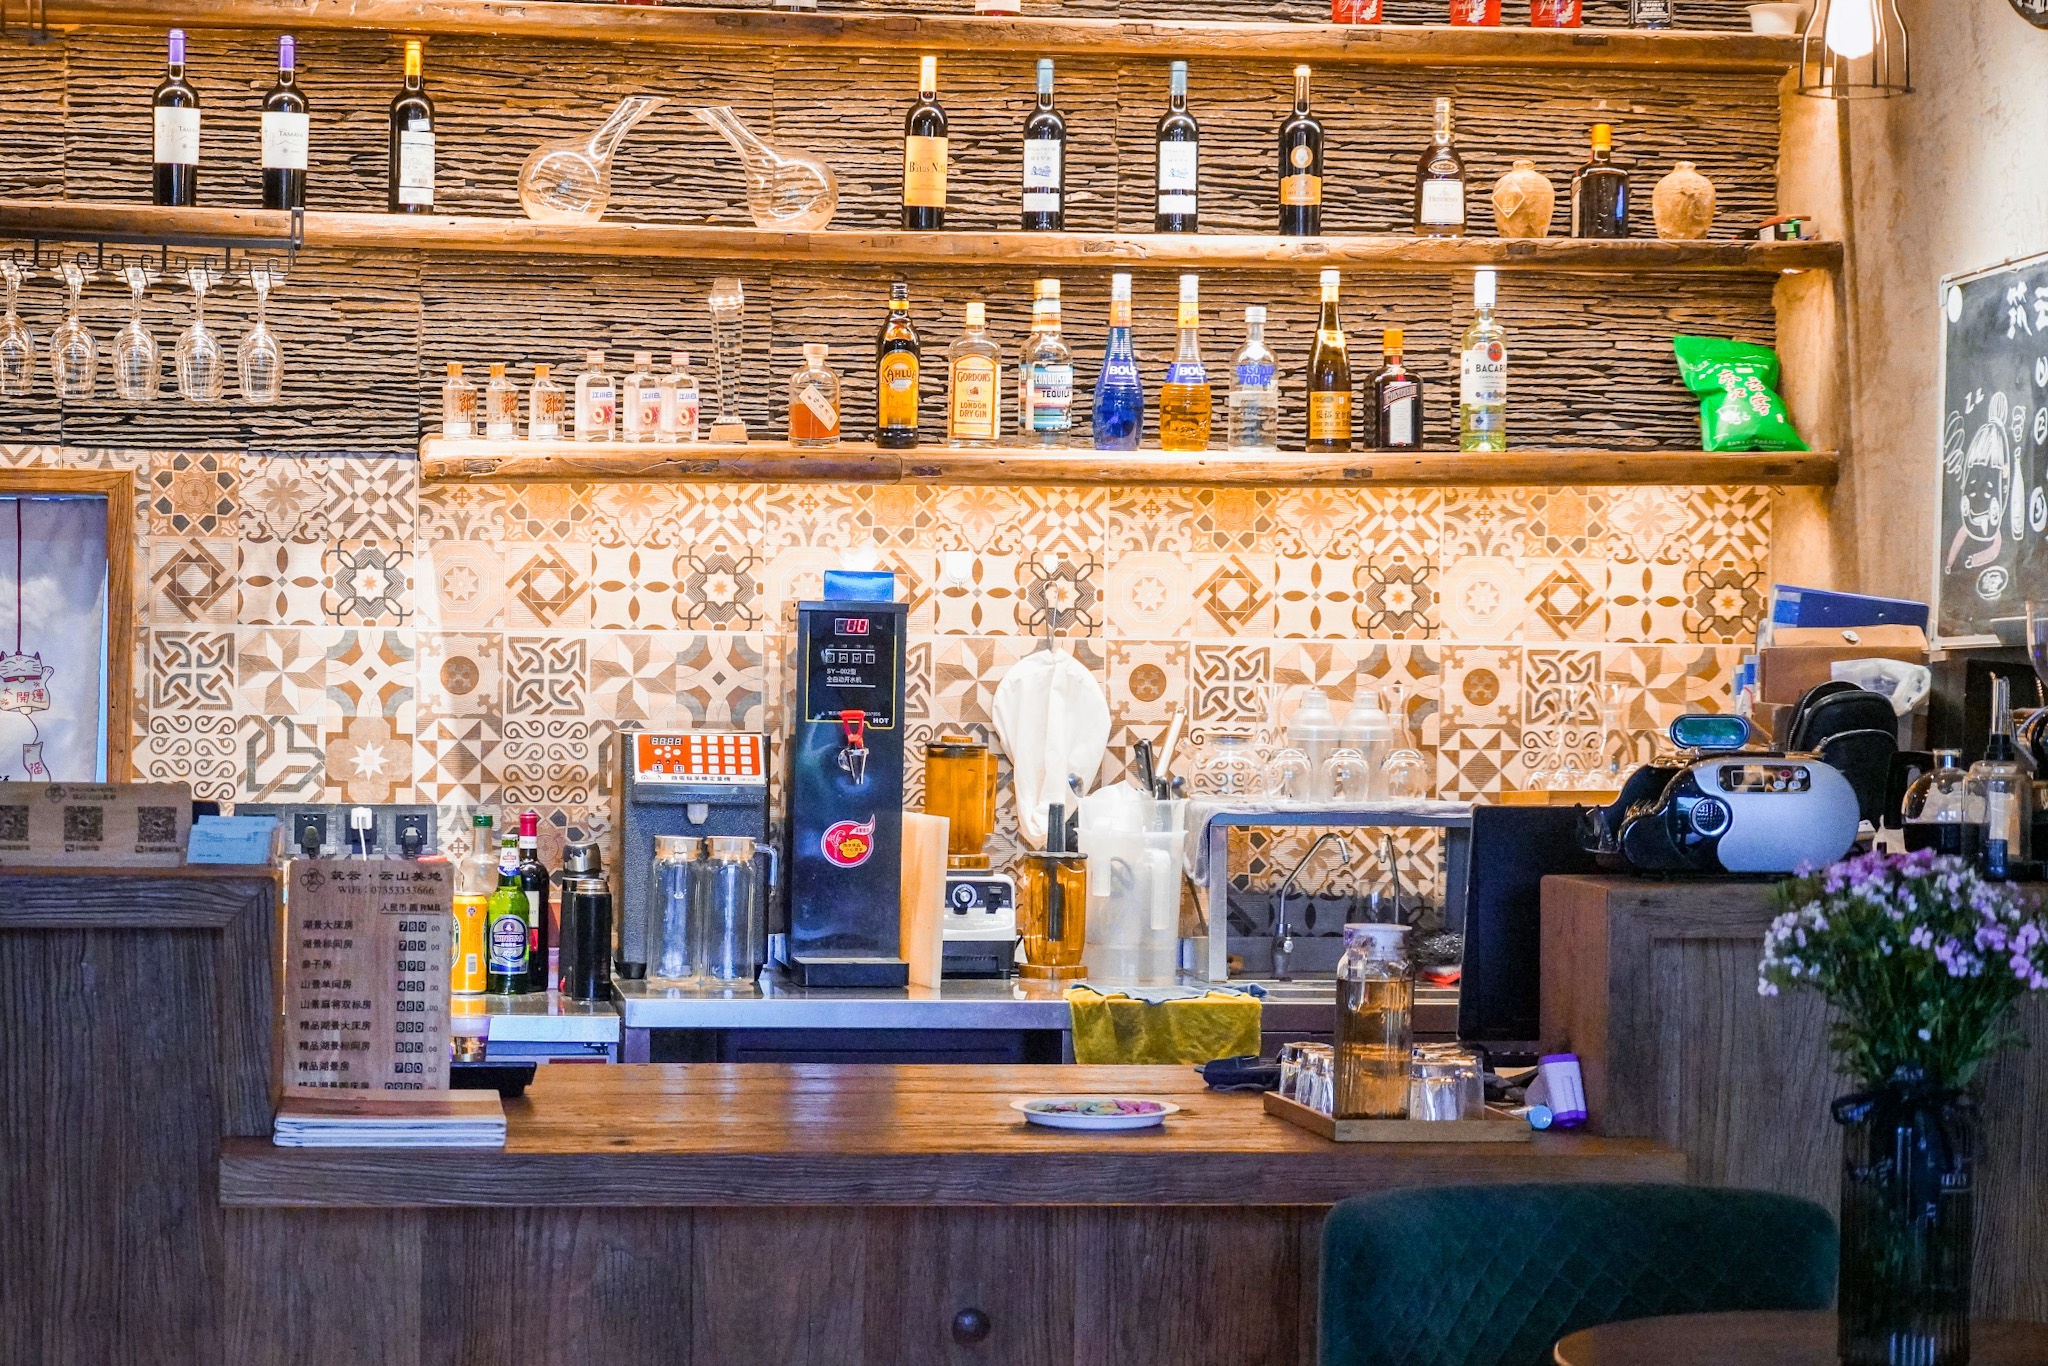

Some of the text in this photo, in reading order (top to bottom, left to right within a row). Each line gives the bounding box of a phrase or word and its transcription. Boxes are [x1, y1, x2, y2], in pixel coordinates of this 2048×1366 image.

[881, 365, 918, 384] KAHLÚA
[1109, 366, 1137, 375] BOLS
[1179, 366, 1205, 376] BOLS
[957, 371, 991, 382] GORDON'S
[1240, 376, 1271, 385] VODKA
[1042, 389, 1070, 397] TEQUILA
[16, 689, 47, 703] 開運
[30, 762, 42, 775] 福
[381, 903, 407, 912] 人民币
[420, 903, 441, 911] RMB
[399, 921, 427, 932] 780
[399, 940, 426, 951] 780
[398, 960, 426, 971] 398
[397, 980, 425, 991] 428
[396, 1001, 425, 1012] 680
[396, 1021, 424, 1032] 880
[395, 1042, 424, 1053] 880
[299, 1062, 349, 1071] 精品湖景房
[394, 1062, 423, 1073] 780
